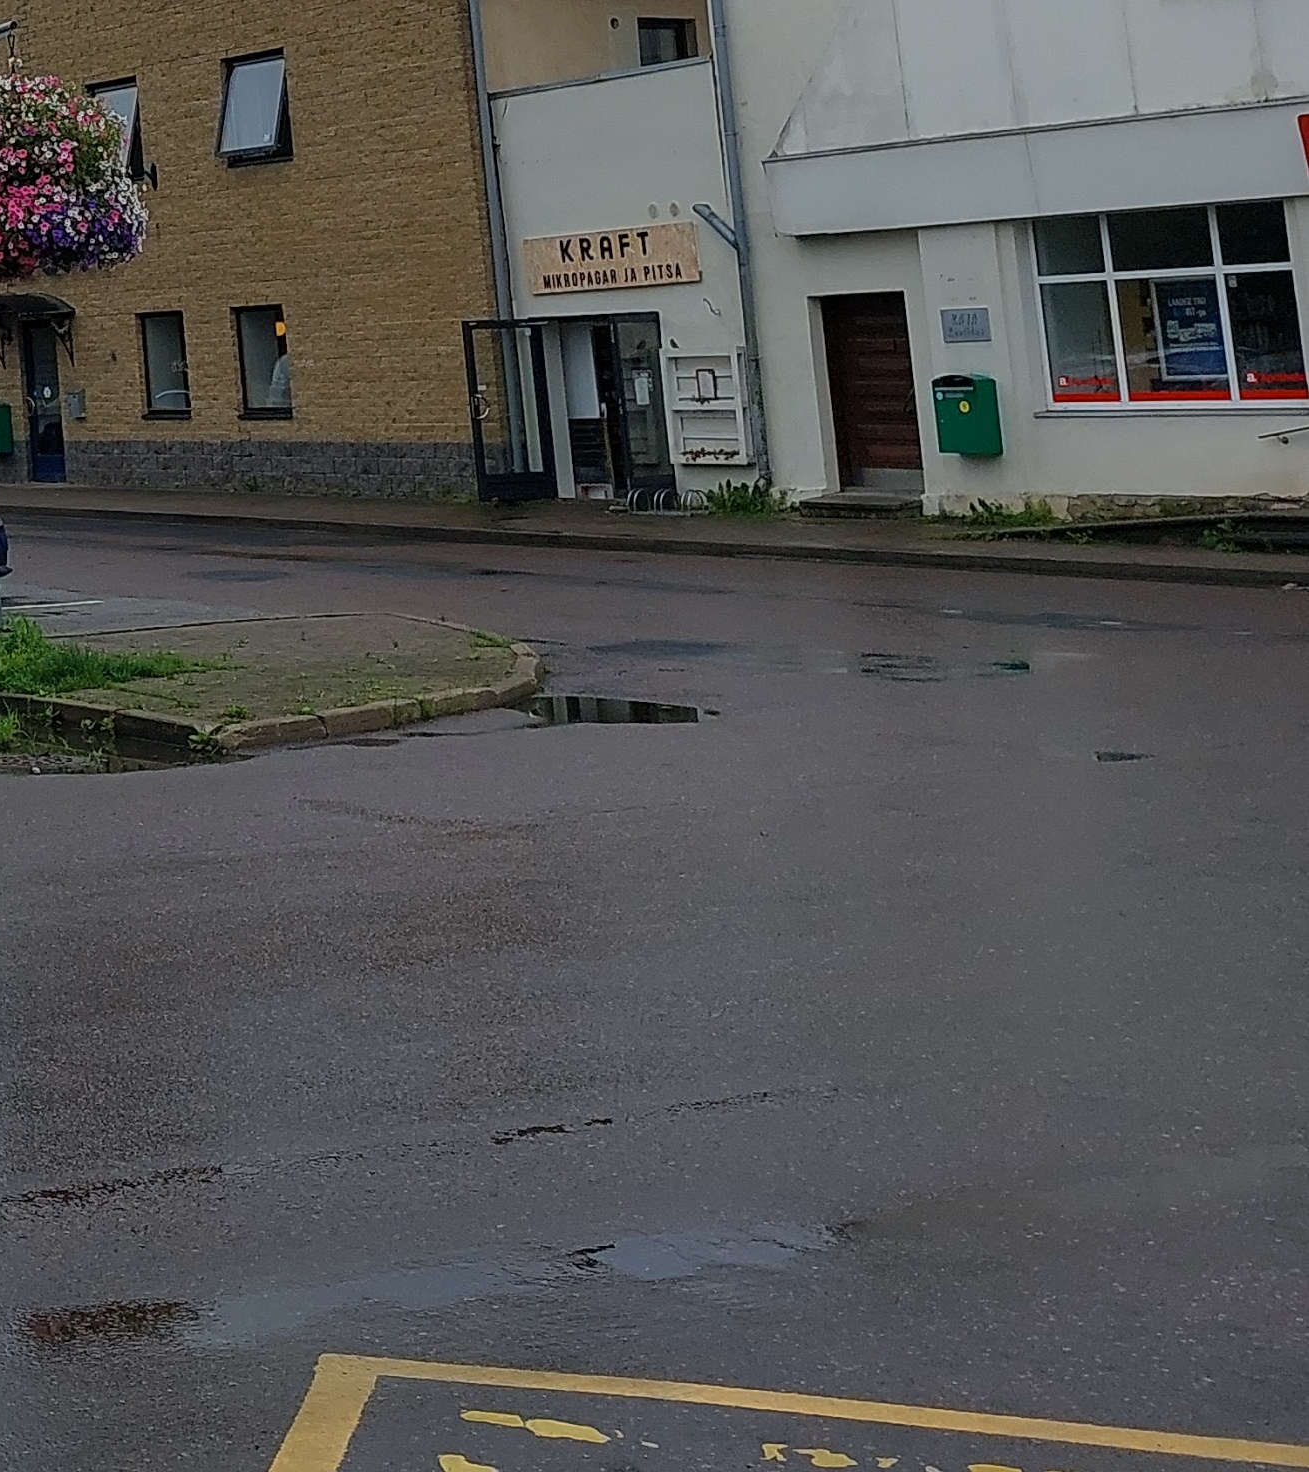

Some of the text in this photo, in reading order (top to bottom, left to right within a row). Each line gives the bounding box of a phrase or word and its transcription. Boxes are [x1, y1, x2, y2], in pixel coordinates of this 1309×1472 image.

[559, 231, 649, 264] KRAFT
[543, 262, 683, 290] MIKROPAGAR JA PITSA
